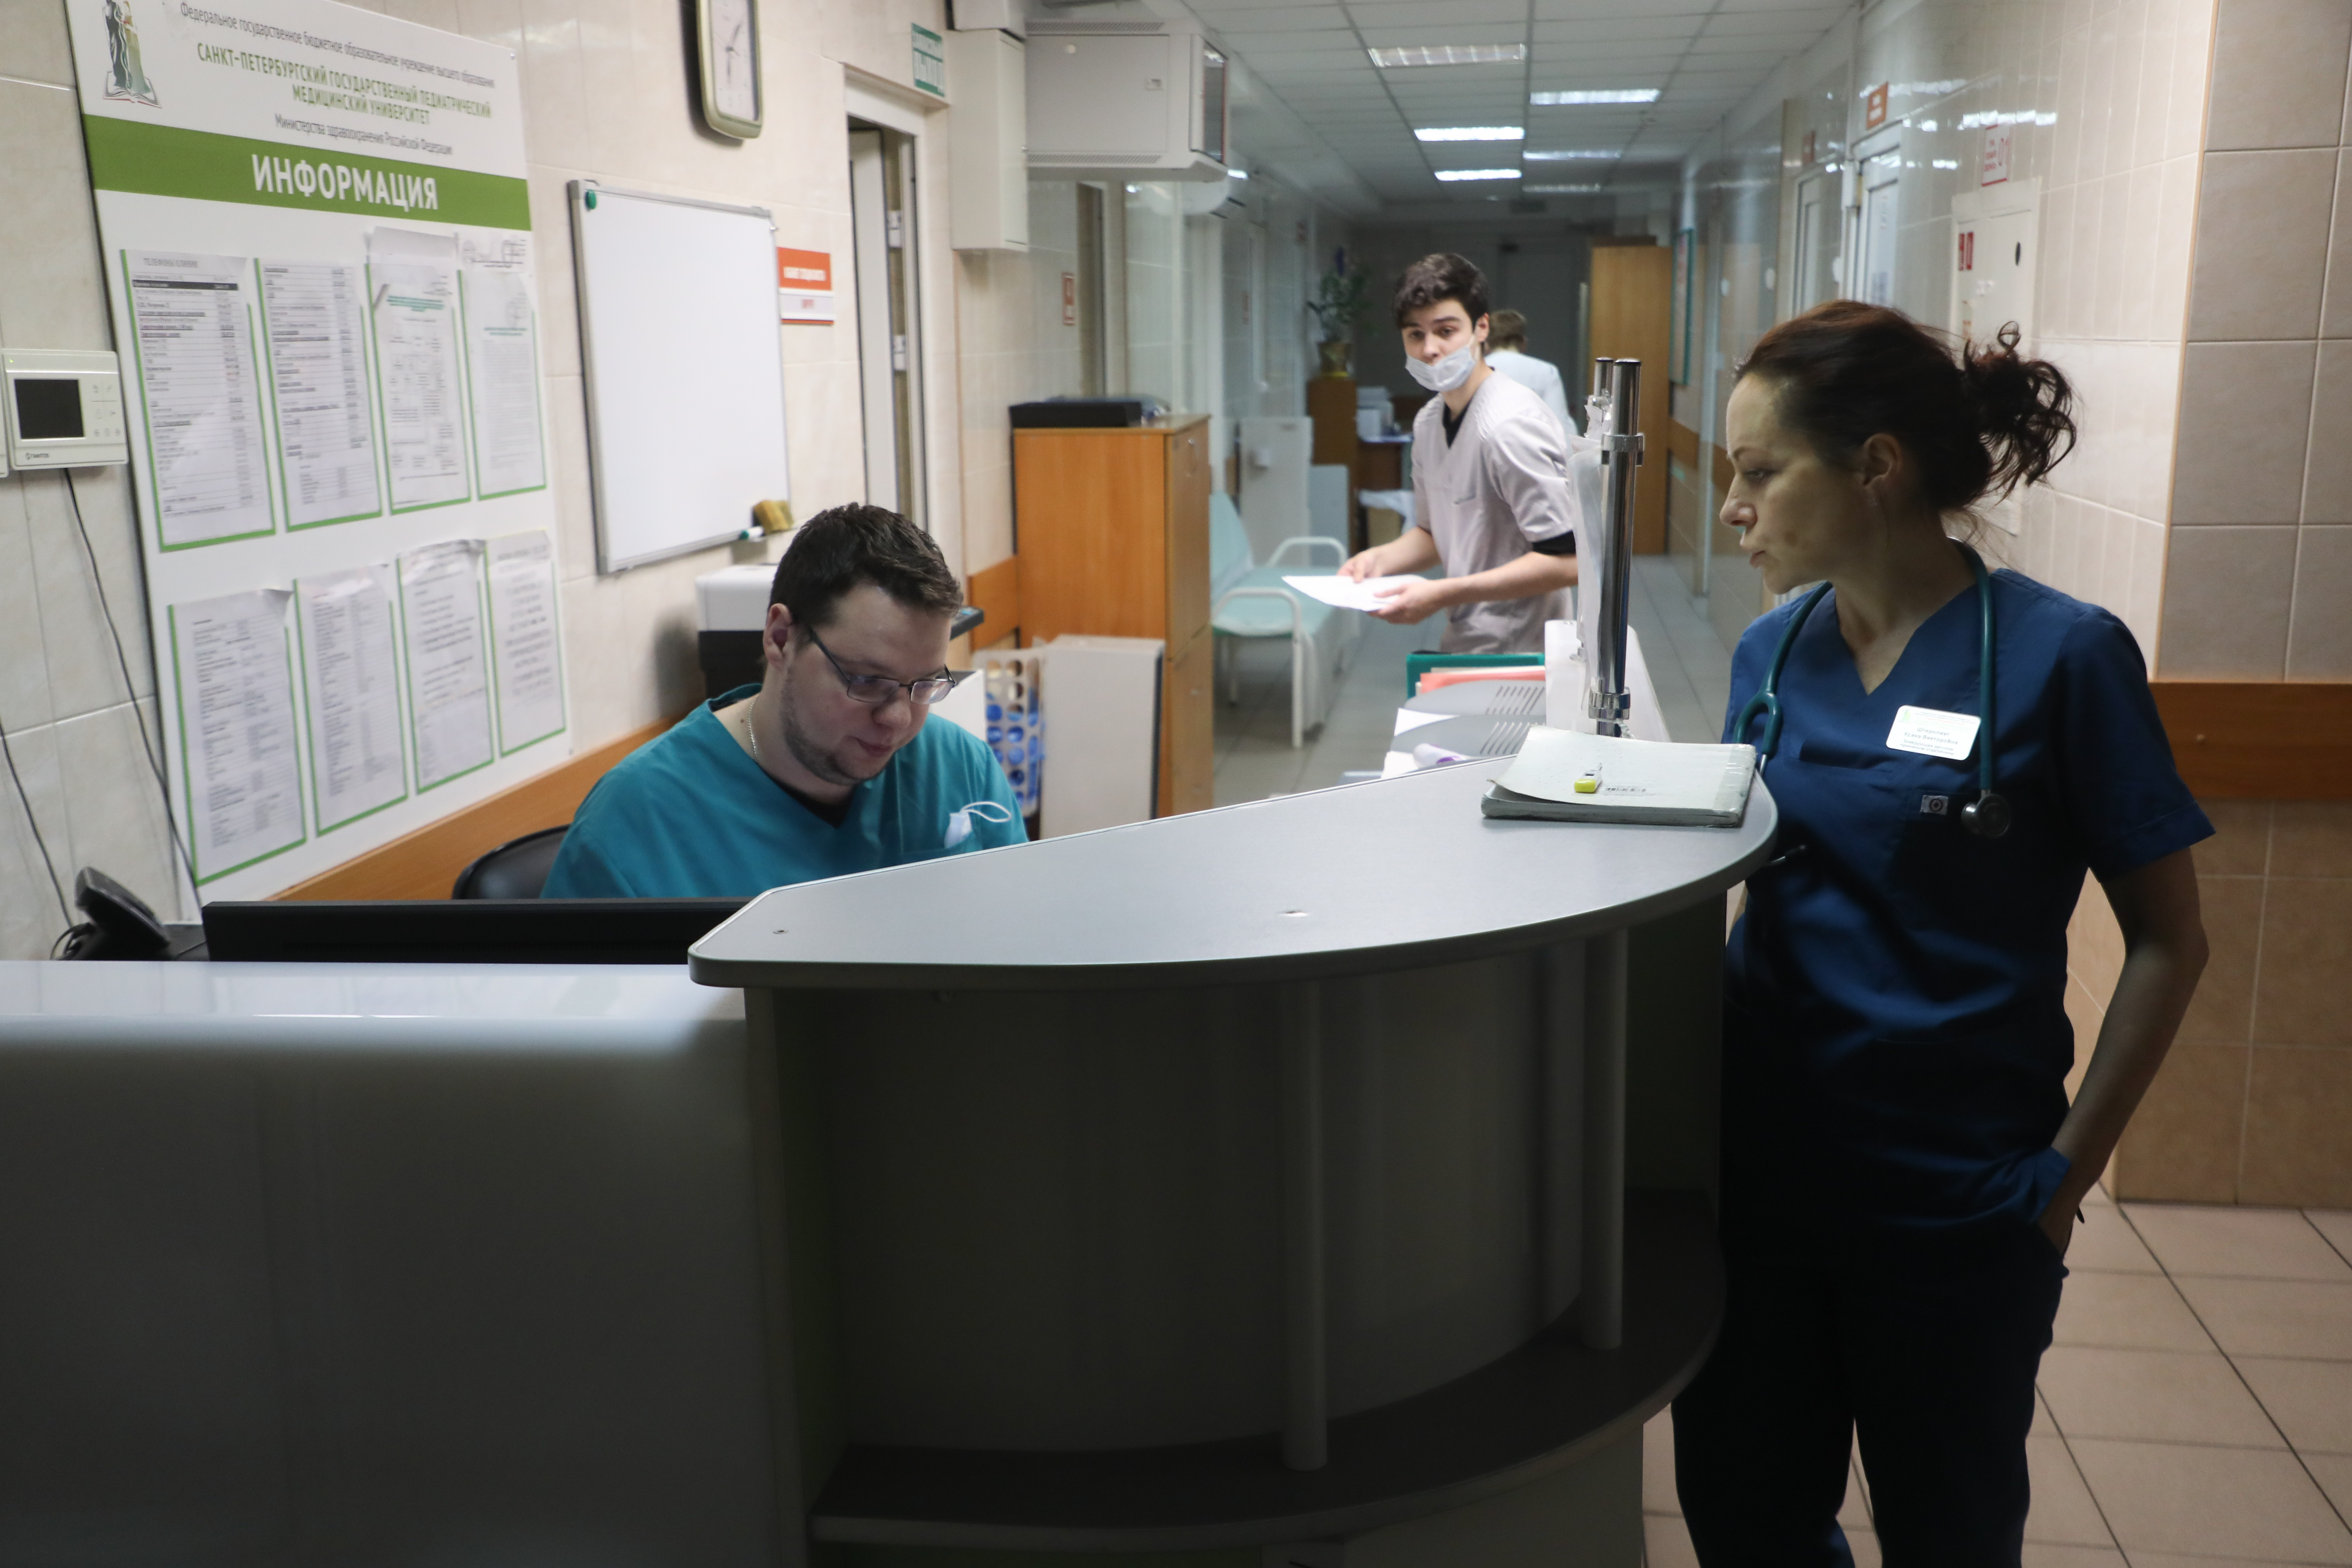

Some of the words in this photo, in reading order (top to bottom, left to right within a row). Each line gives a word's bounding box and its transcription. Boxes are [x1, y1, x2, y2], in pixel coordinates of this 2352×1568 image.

[181, 3, 238, 29] Федеральное
[239, 19, 302, 44] государственное
[303, 31, 343, 53] бюджетное
[198, 43, 328, 85] САНКТ-ПЕТЕРБУРГСКИЙ
[330, 70, 419, 104] ГОСУДАРСТВЕННЫЙ
[420, 90, 492, 118] ПЕДИАТРИЧЕСКИЙ
[275, 113, 326, 135] Министерства
[292, 84, 369, 113] МЕДИЦИНСКИЙ
[370, 100, 430, 124] УНИВЕРСИТЕТ
[252, 154, 438, 212] ИНФОРМАЦИЯ
[1923, 735, 1958, 745] Викторовна
